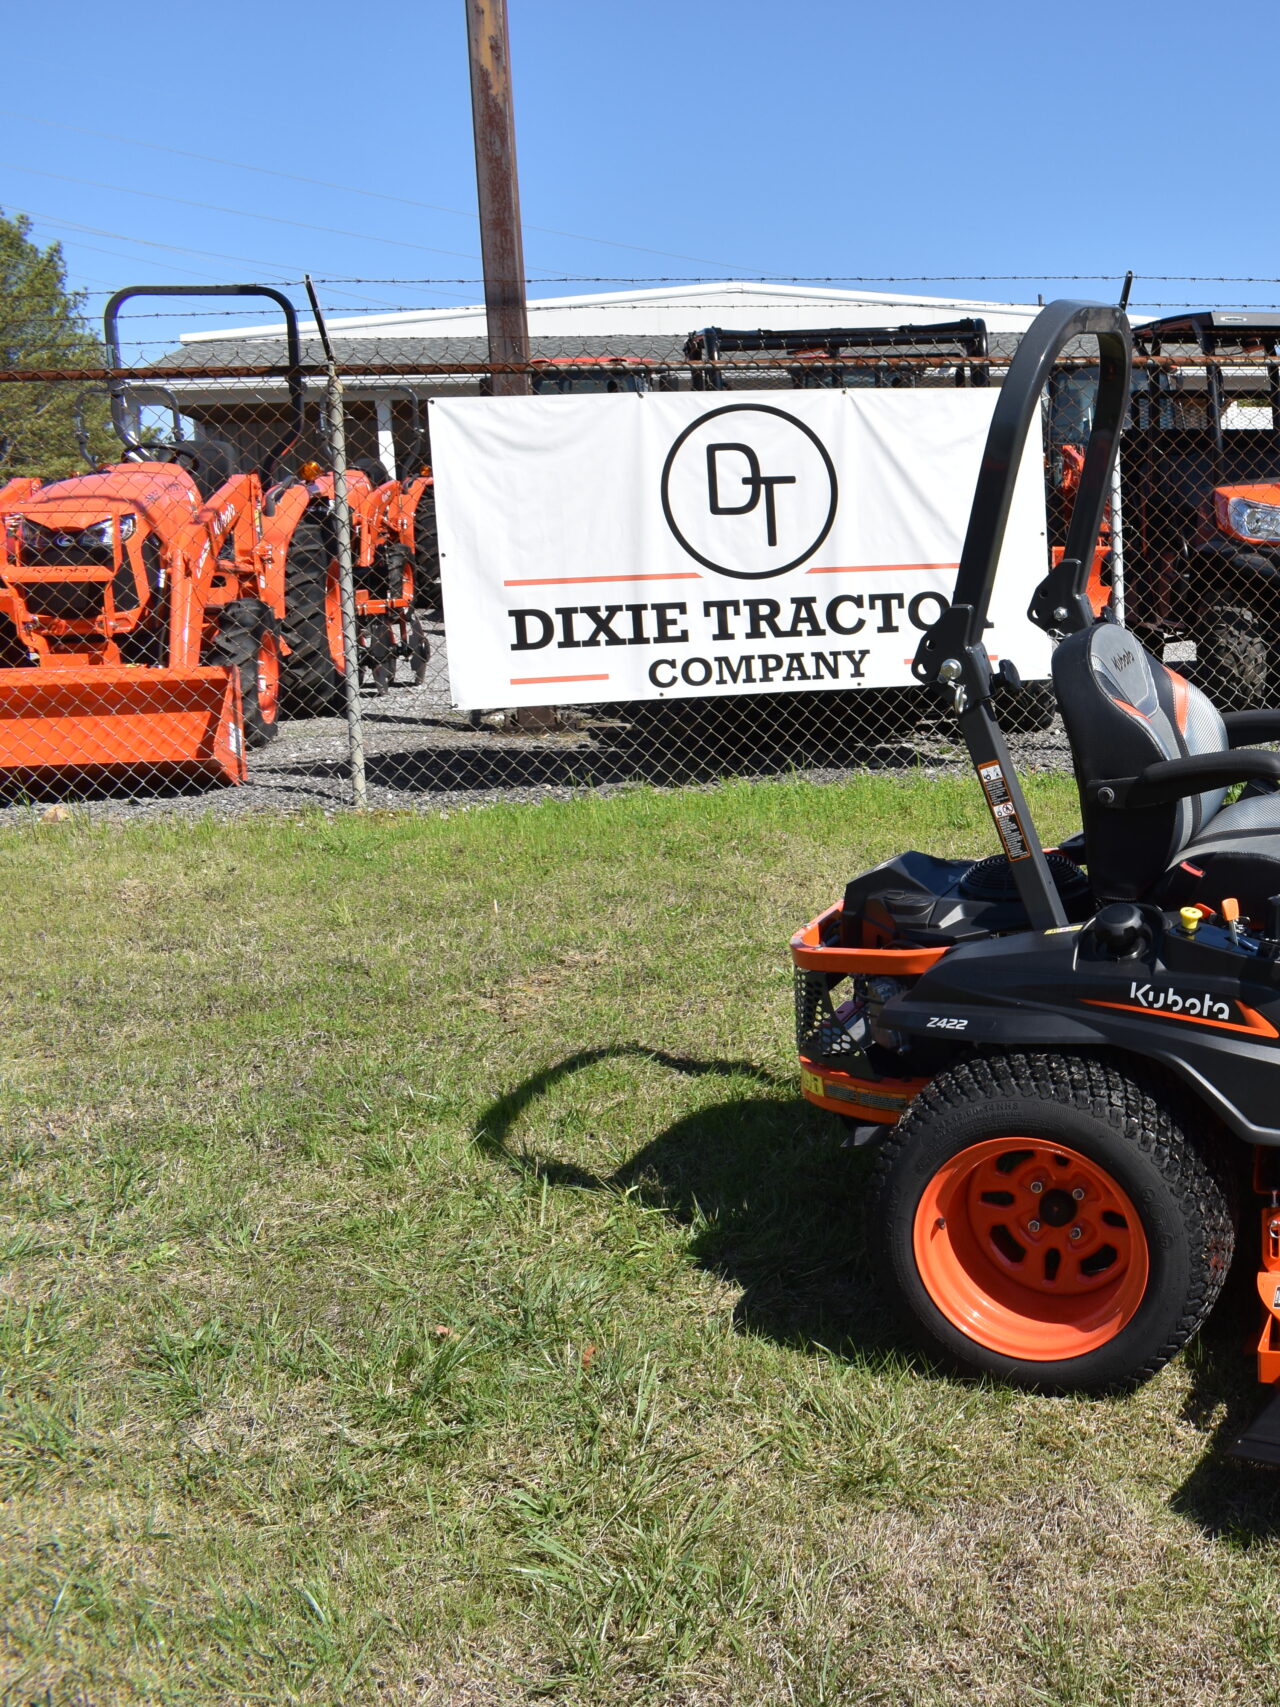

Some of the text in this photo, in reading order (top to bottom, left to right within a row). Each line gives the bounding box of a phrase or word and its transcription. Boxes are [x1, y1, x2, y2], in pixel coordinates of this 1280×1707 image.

[507, 591, 995, 651] DIXIE TRACTO
[648, 649, 871, 690] COMPANY
[1130, 981, 1230, 1020] Kubota
[926, 1017, 969, 1030] Z422
